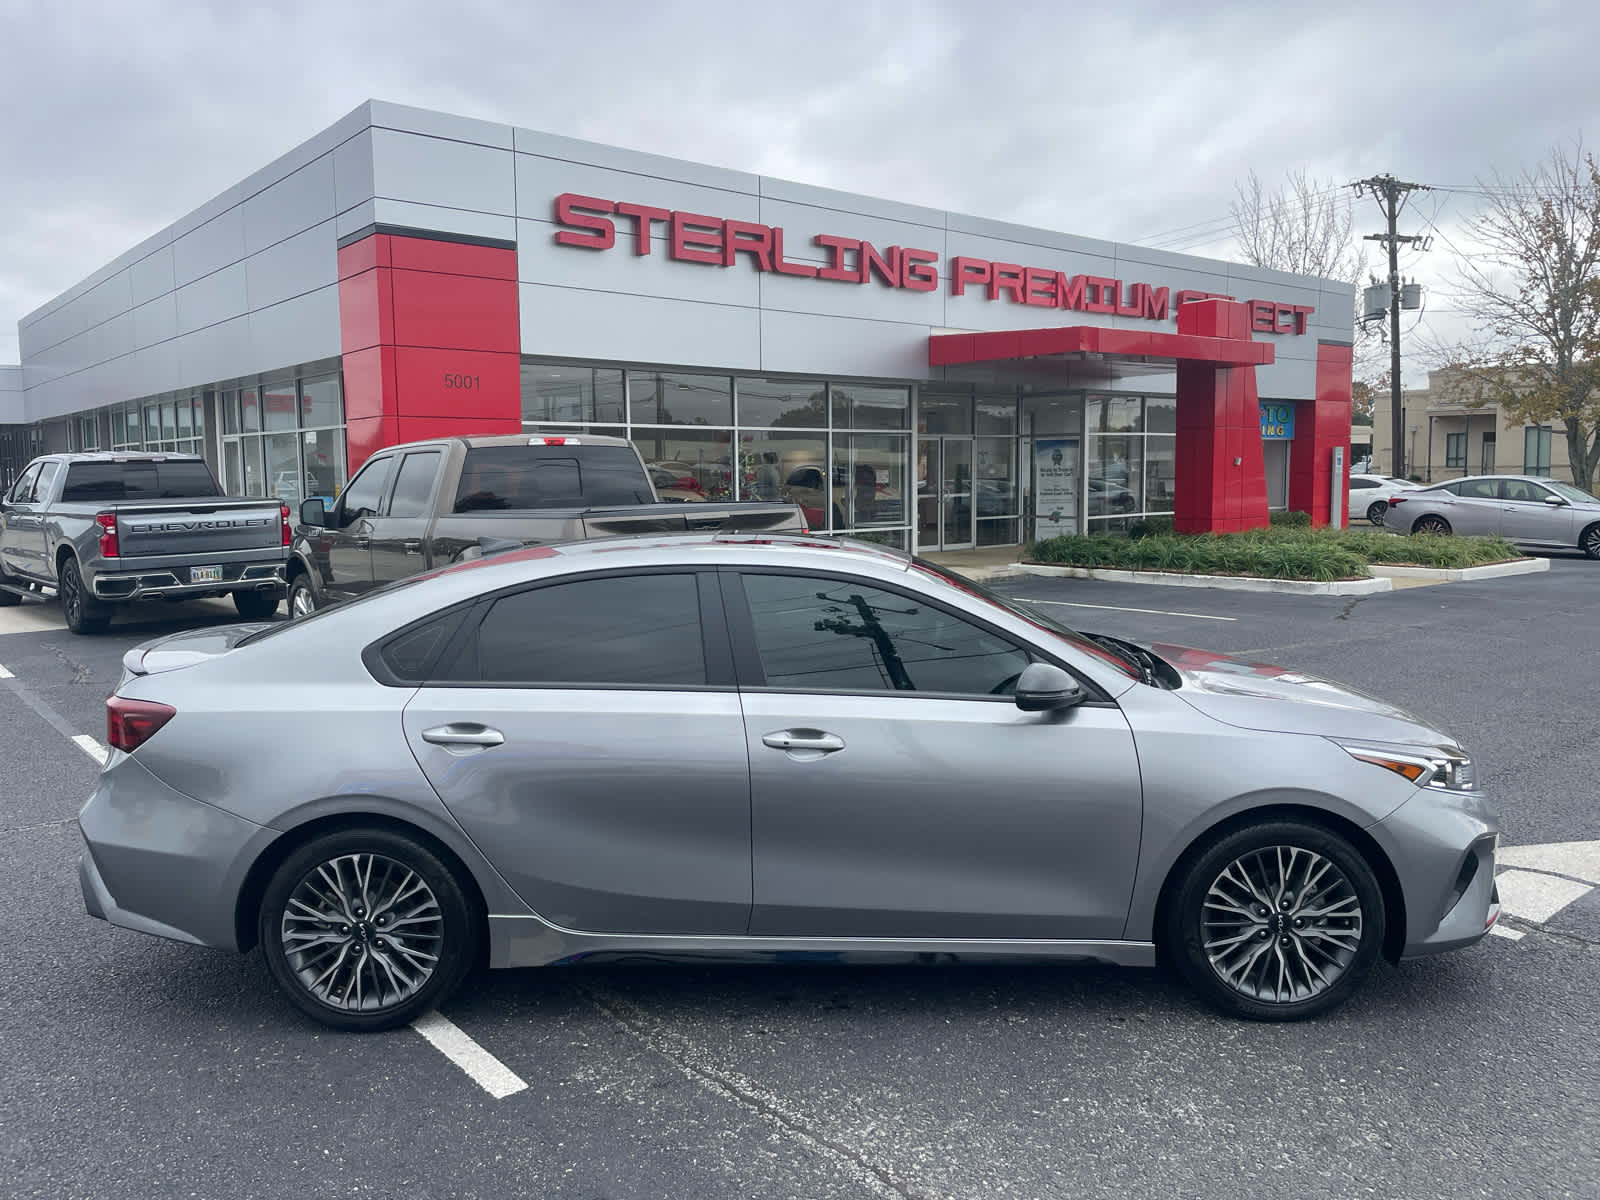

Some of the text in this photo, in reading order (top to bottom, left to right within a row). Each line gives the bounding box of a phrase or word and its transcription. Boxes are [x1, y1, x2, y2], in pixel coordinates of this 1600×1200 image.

[554, 192, 939, 292] STERLING
[952, 255, 1169, 321] PREMIUM
[444, 373, 480, 391] 5001
[1261, 424, 1285, 436] ING
[131, 518, 273, 534] CHEVROLET
